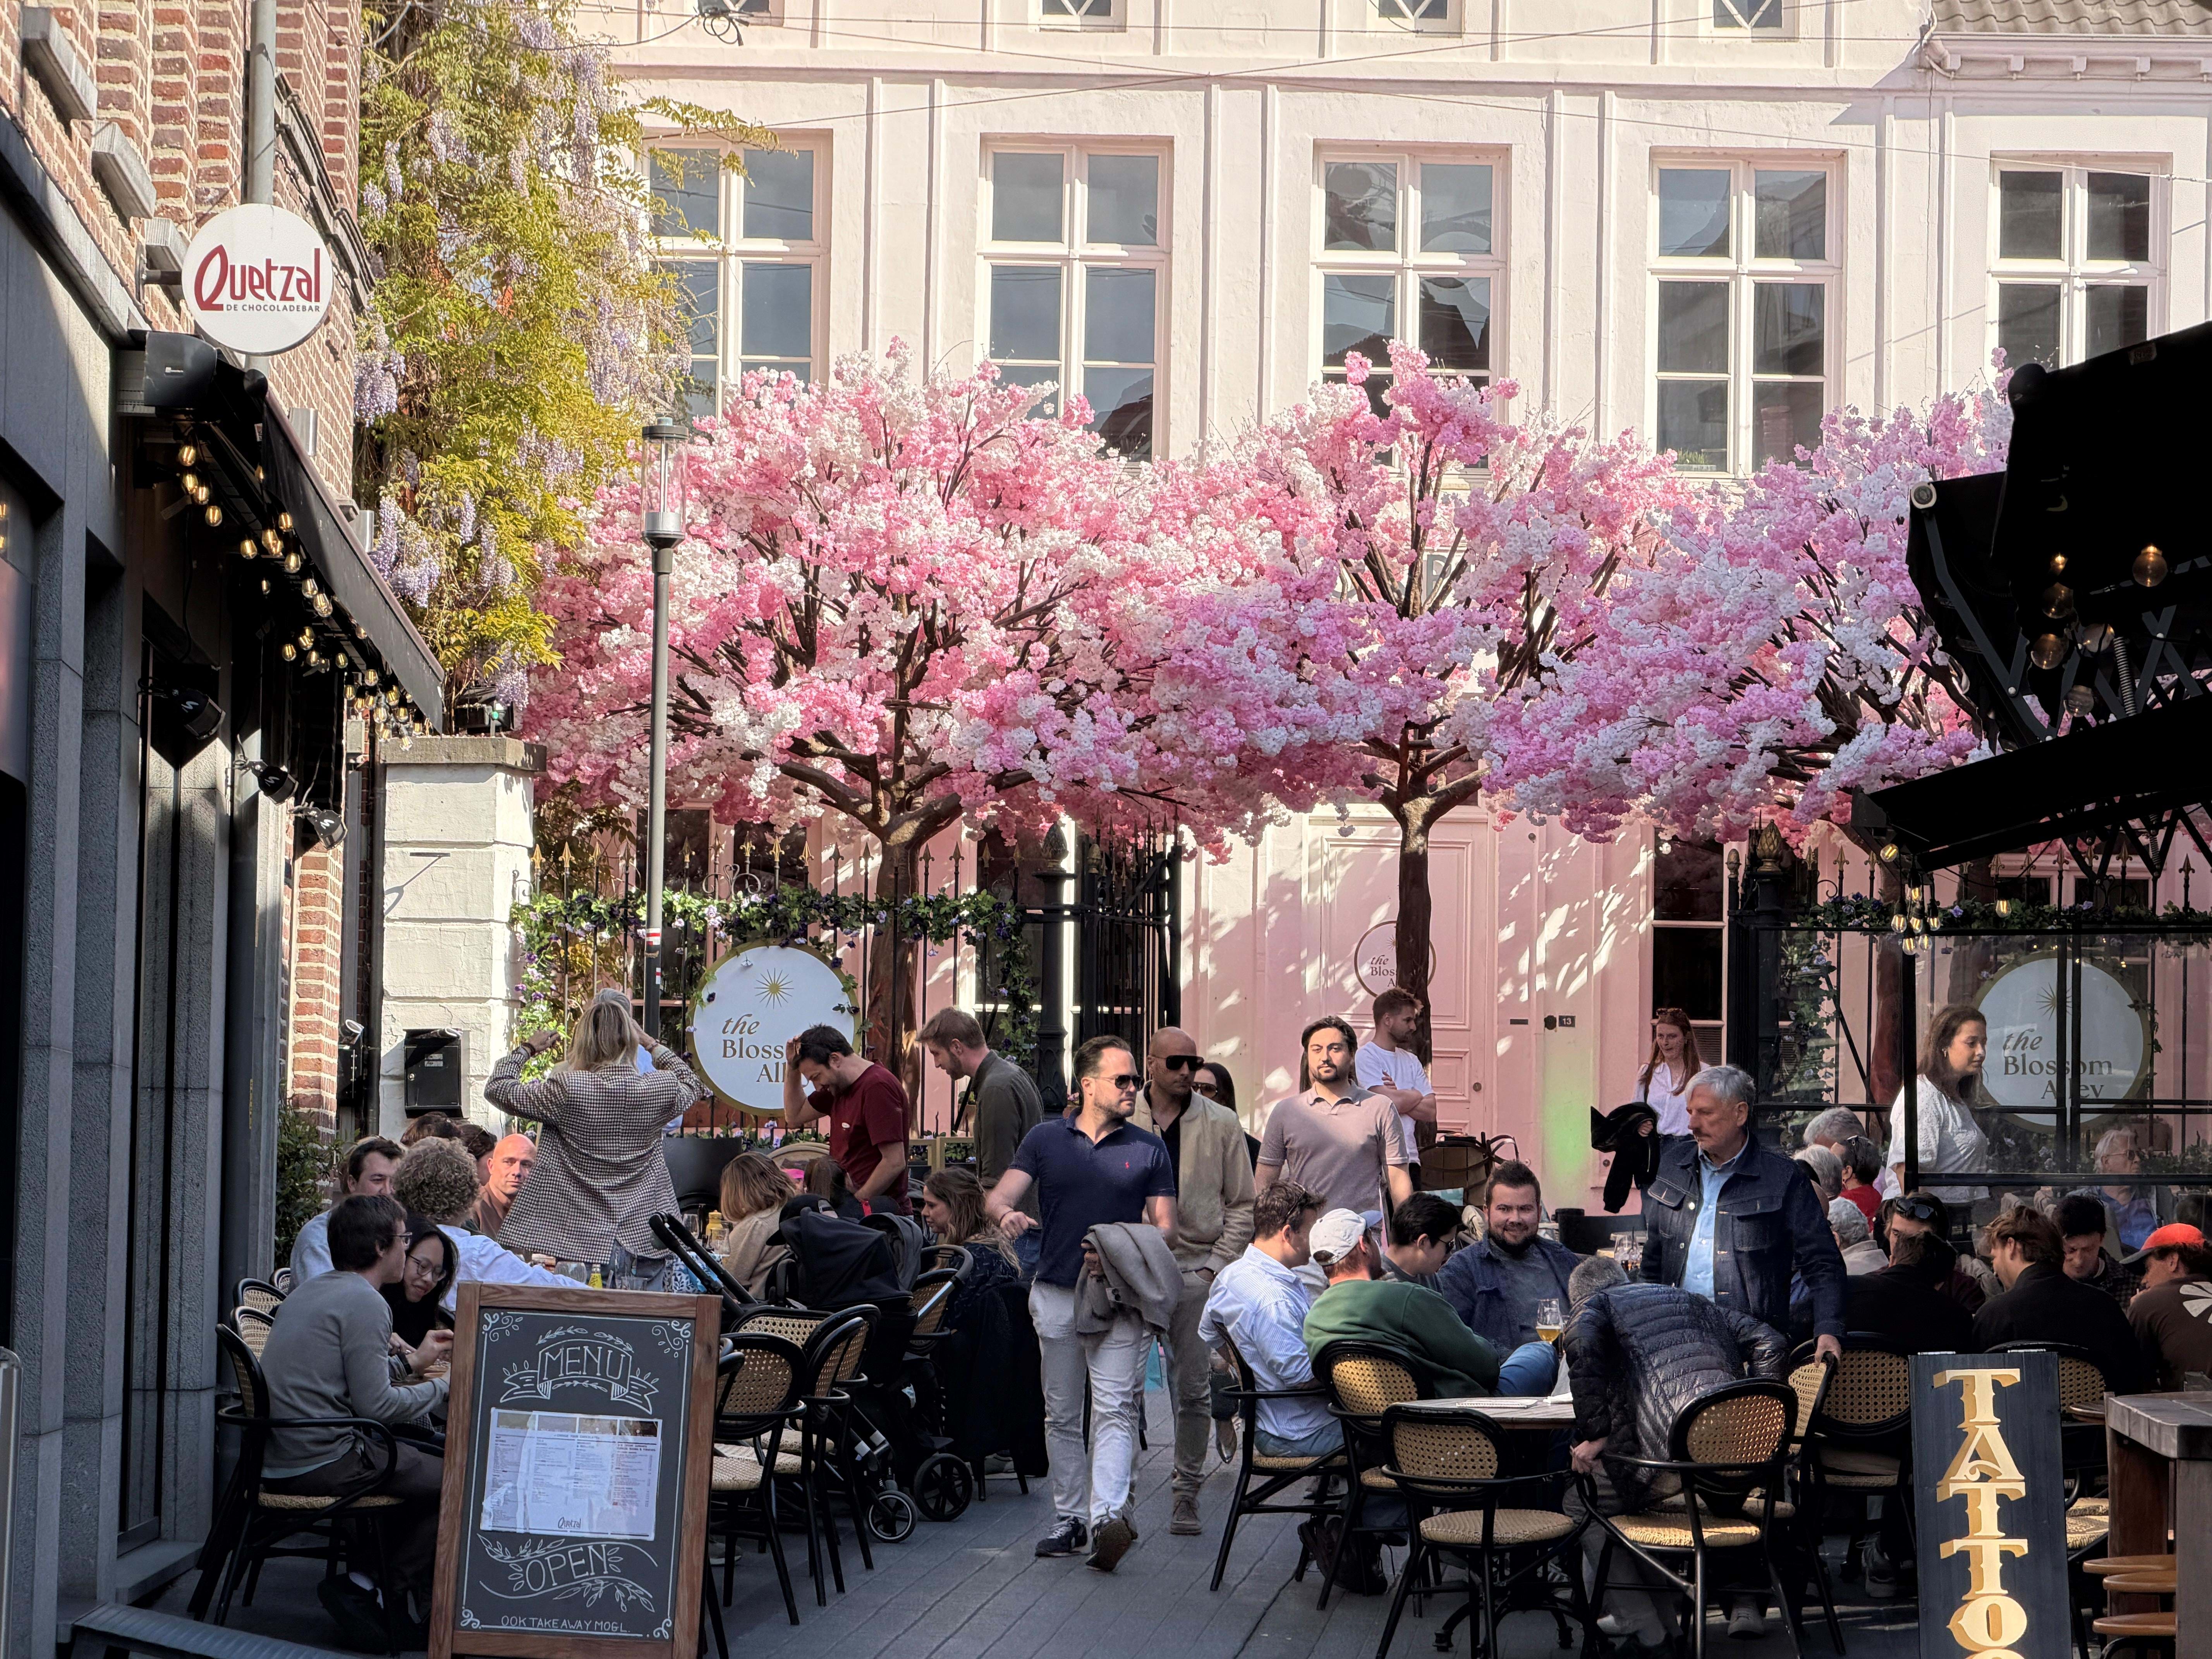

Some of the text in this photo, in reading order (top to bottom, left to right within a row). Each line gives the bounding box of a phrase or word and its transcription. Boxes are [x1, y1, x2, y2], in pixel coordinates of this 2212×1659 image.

[194, 244, 320, 311] Quetzal
[242, 304, 320, 312] CHOCOLADEBAR
[1370, 966, 1395, 976] Blos
[1371, 955, 1389, 965] the
[722, 1013, 760, 1035] the
[722, 1037, 784, 1059] Bloss
[2003, 1028, 2043, 1051] the
[544, 1345, 626, 1380] MENU
[1933, 1368, 2028, 1659] TATTO
[526, 1544, 610, 1592] OPEN
[501, 1615, 527, 1627] OOK
[594, 1620, 630, 1633] MOGL.
